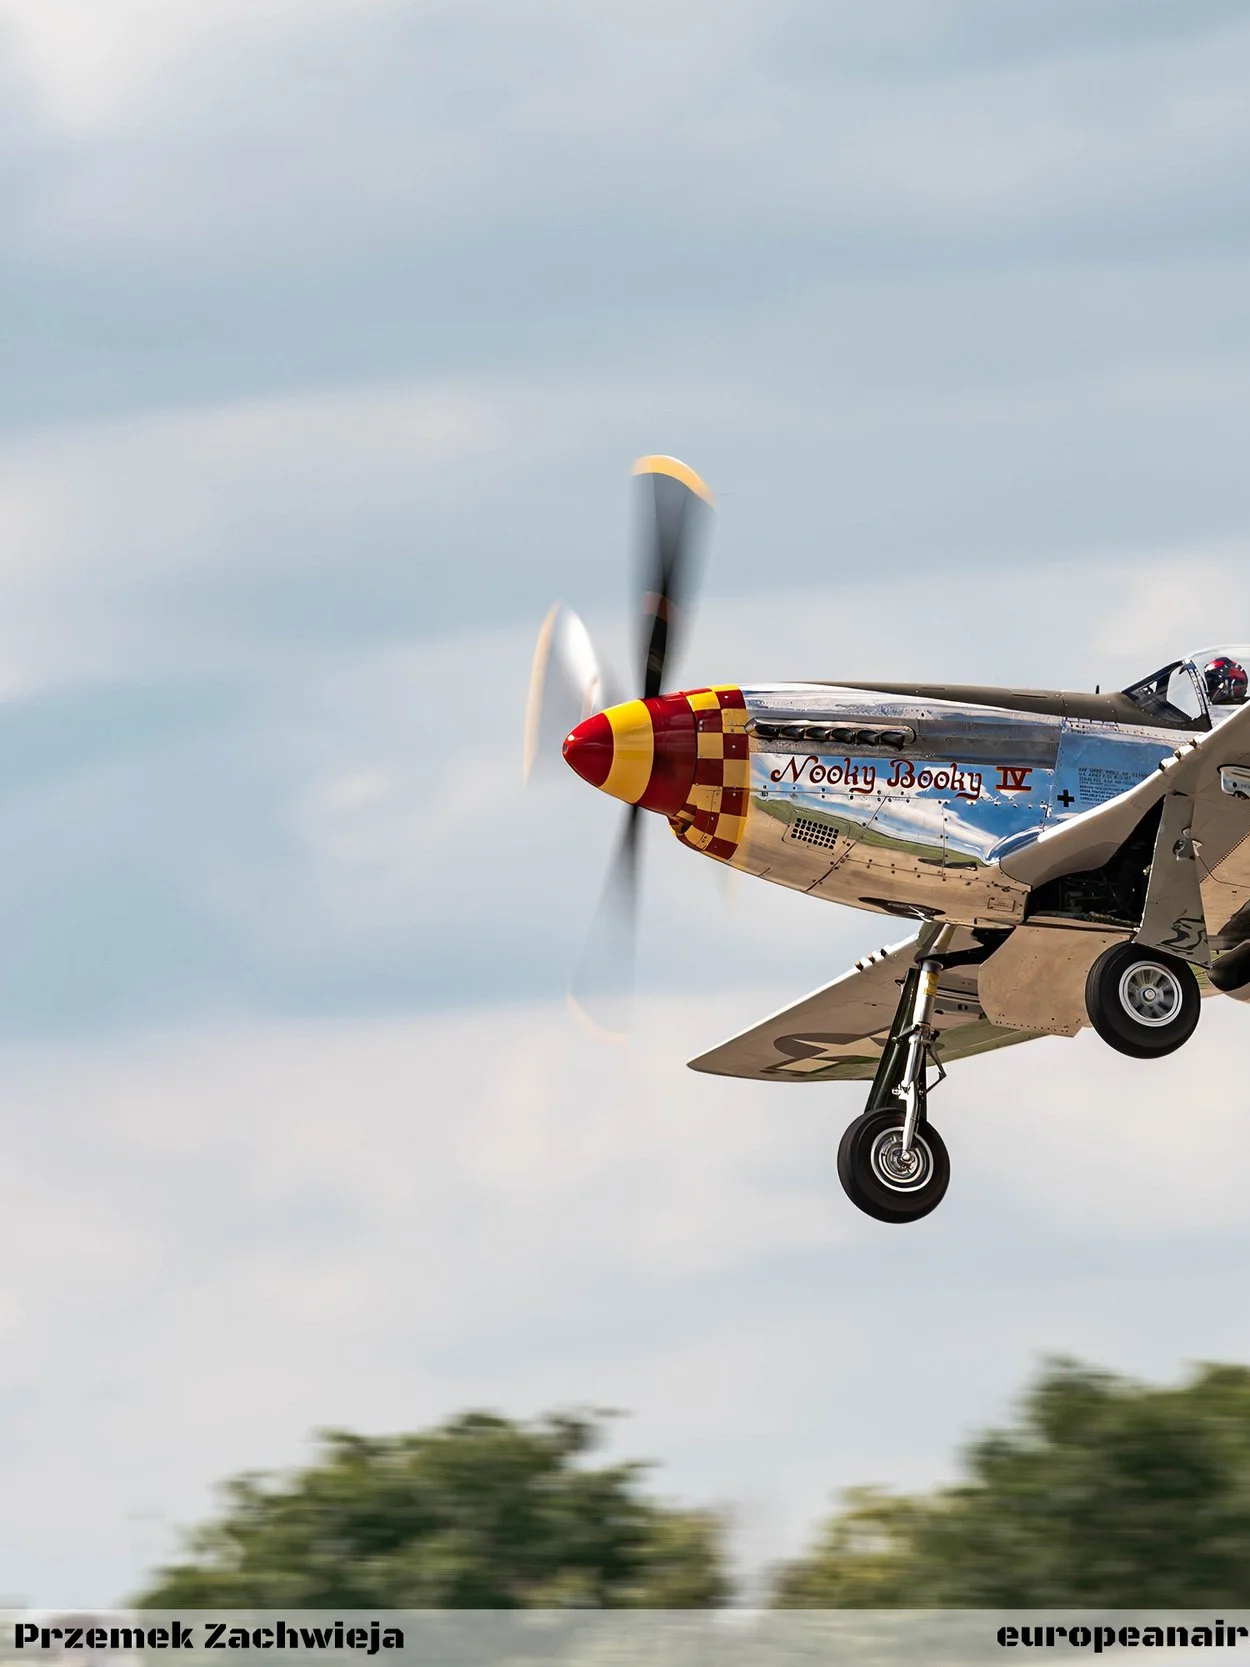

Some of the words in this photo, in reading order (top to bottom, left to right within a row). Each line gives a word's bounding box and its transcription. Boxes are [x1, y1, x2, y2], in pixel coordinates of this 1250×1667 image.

[770, 755, 876, 794] Nooky
[887, 758, 982, 800] Booky
[995, 766, 1032, 792] IV
